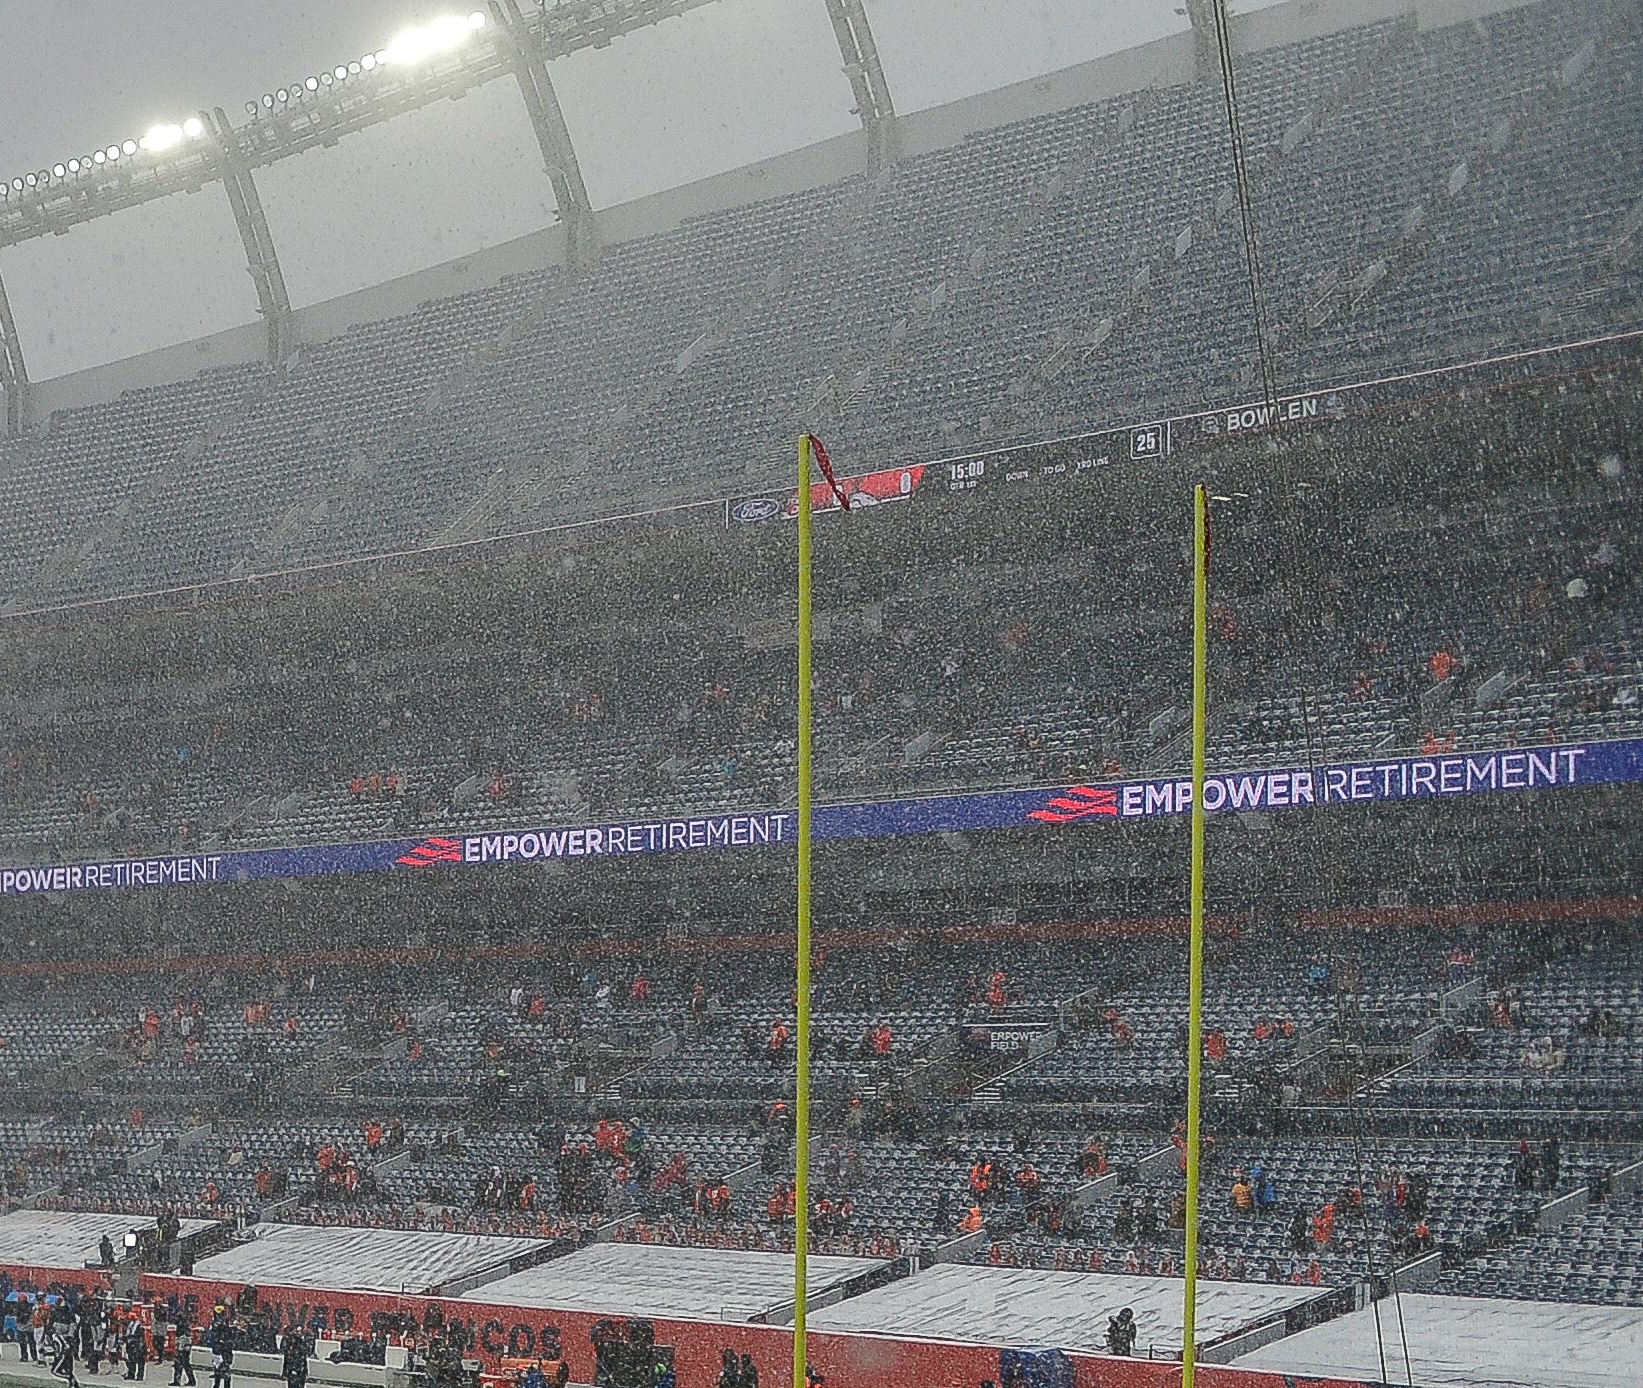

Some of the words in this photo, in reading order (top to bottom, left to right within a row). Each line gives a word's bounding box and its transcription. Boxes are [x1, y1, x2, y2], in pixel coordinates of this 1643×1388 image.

[1227, 398, 1317, 432] BOWLEN
[1137, 433, 1157, 452] 25
[950, 461, 985, 481] 15:00
[1121, 771, 1313, 817] EMPOWER
[1325, 748, 1585, 801] RETIREMENT
[465, 828, 604, 864] EMPOWER
[609, 814, 789, 853] RETIREMENT
[85, 856, 221, 889] RETIREMENT
